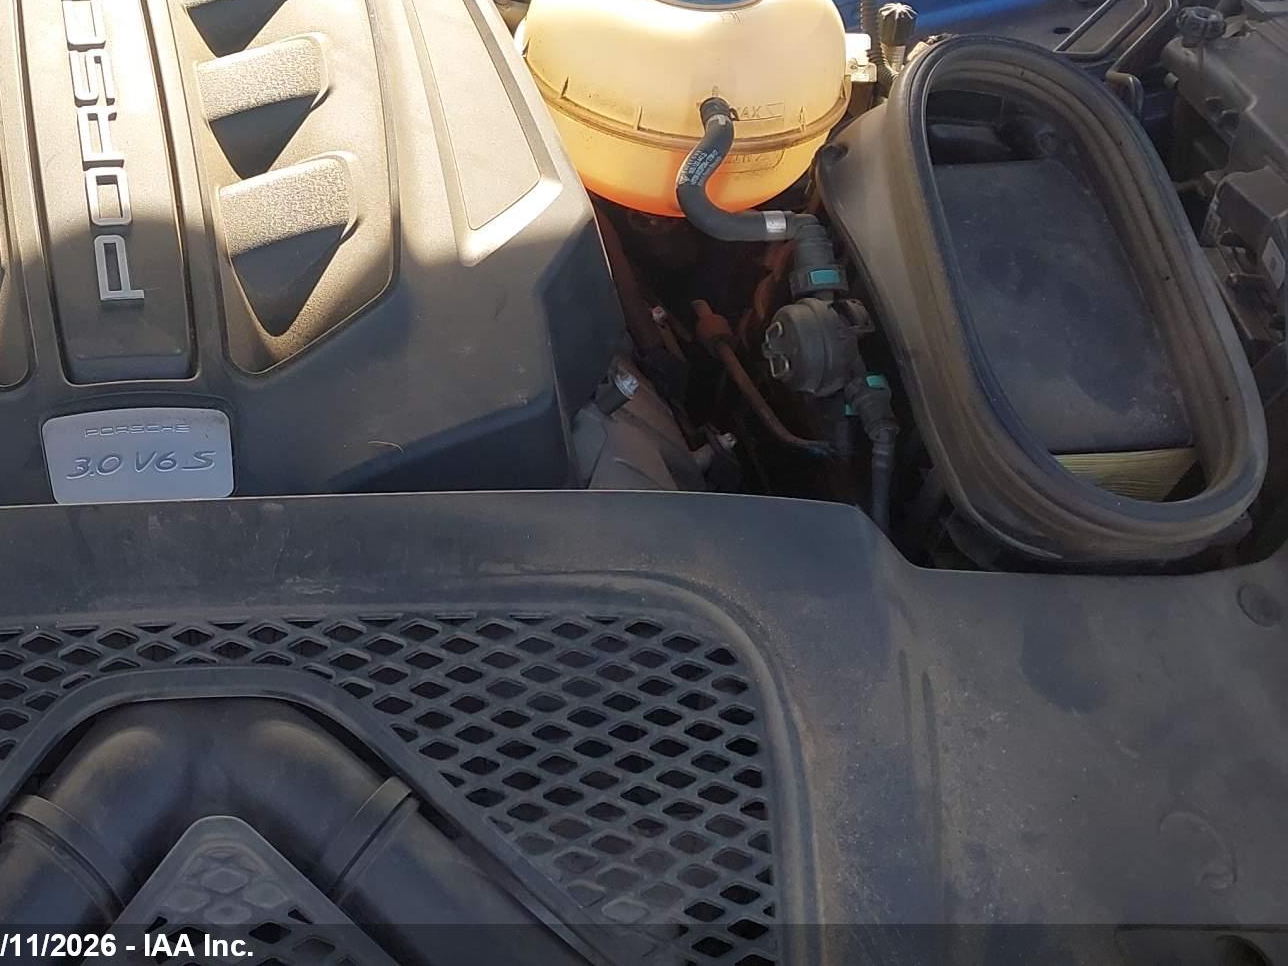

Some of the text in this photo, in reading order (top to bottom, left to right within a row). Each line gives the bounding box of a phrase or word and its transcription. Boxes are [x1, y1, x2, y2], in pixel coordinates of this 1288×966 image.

[84, 423, 191, 438] PORSCHE
[65, 450, 217, 480] 3.0 V6 S
